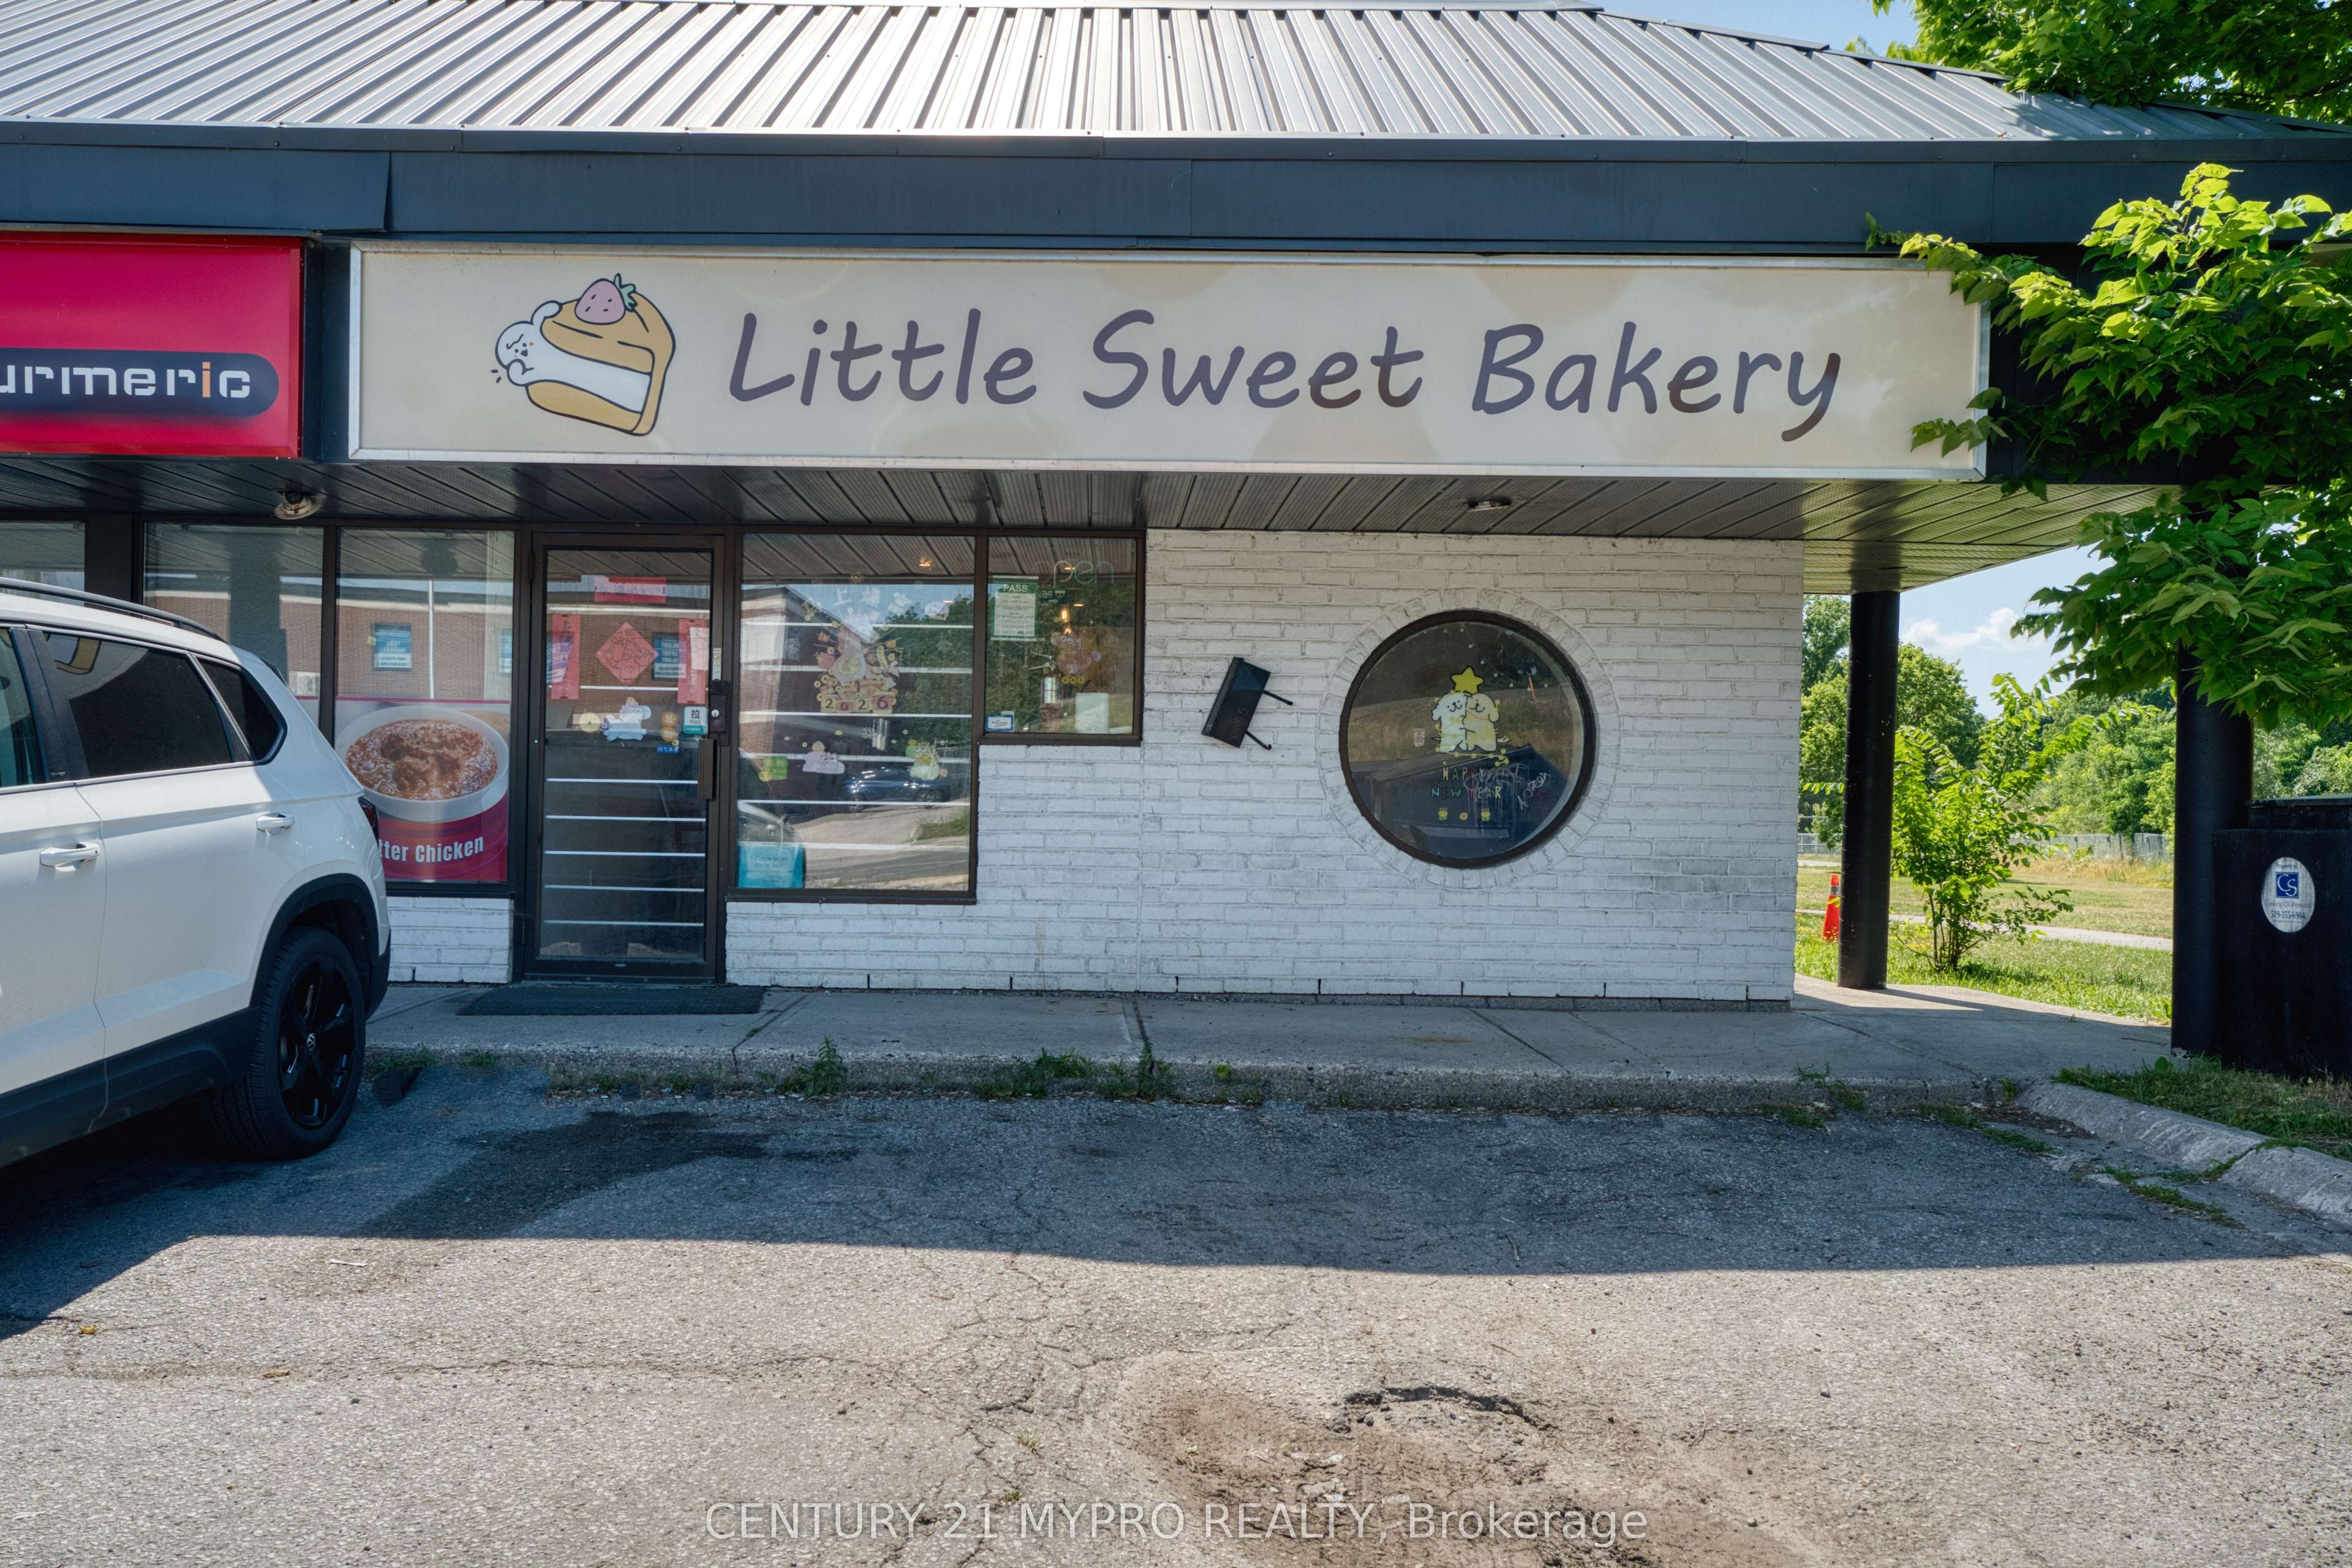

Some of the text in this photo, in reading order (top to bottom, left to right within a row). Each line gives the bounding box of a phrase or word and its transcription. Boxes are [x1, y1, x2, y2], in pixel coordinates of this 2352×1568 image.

[729, 307, 1841, 442] Little Sweet Bakery
[1036, 560, 1114, 589] pen
[1003, 584, 1028, 593] PASS
[825, 695, 889, 711] 2026
[691, 709, 701, 719] 拉
[1442, 766, 1485, 782] HAPPY
[1431, 786, 1502, 800] NEW YEAR
[415, 836, 483, 863] Chicken
[2277, 874, 2297, 897] CS
[2271, 910, 2306, 920] 519-355-6904
